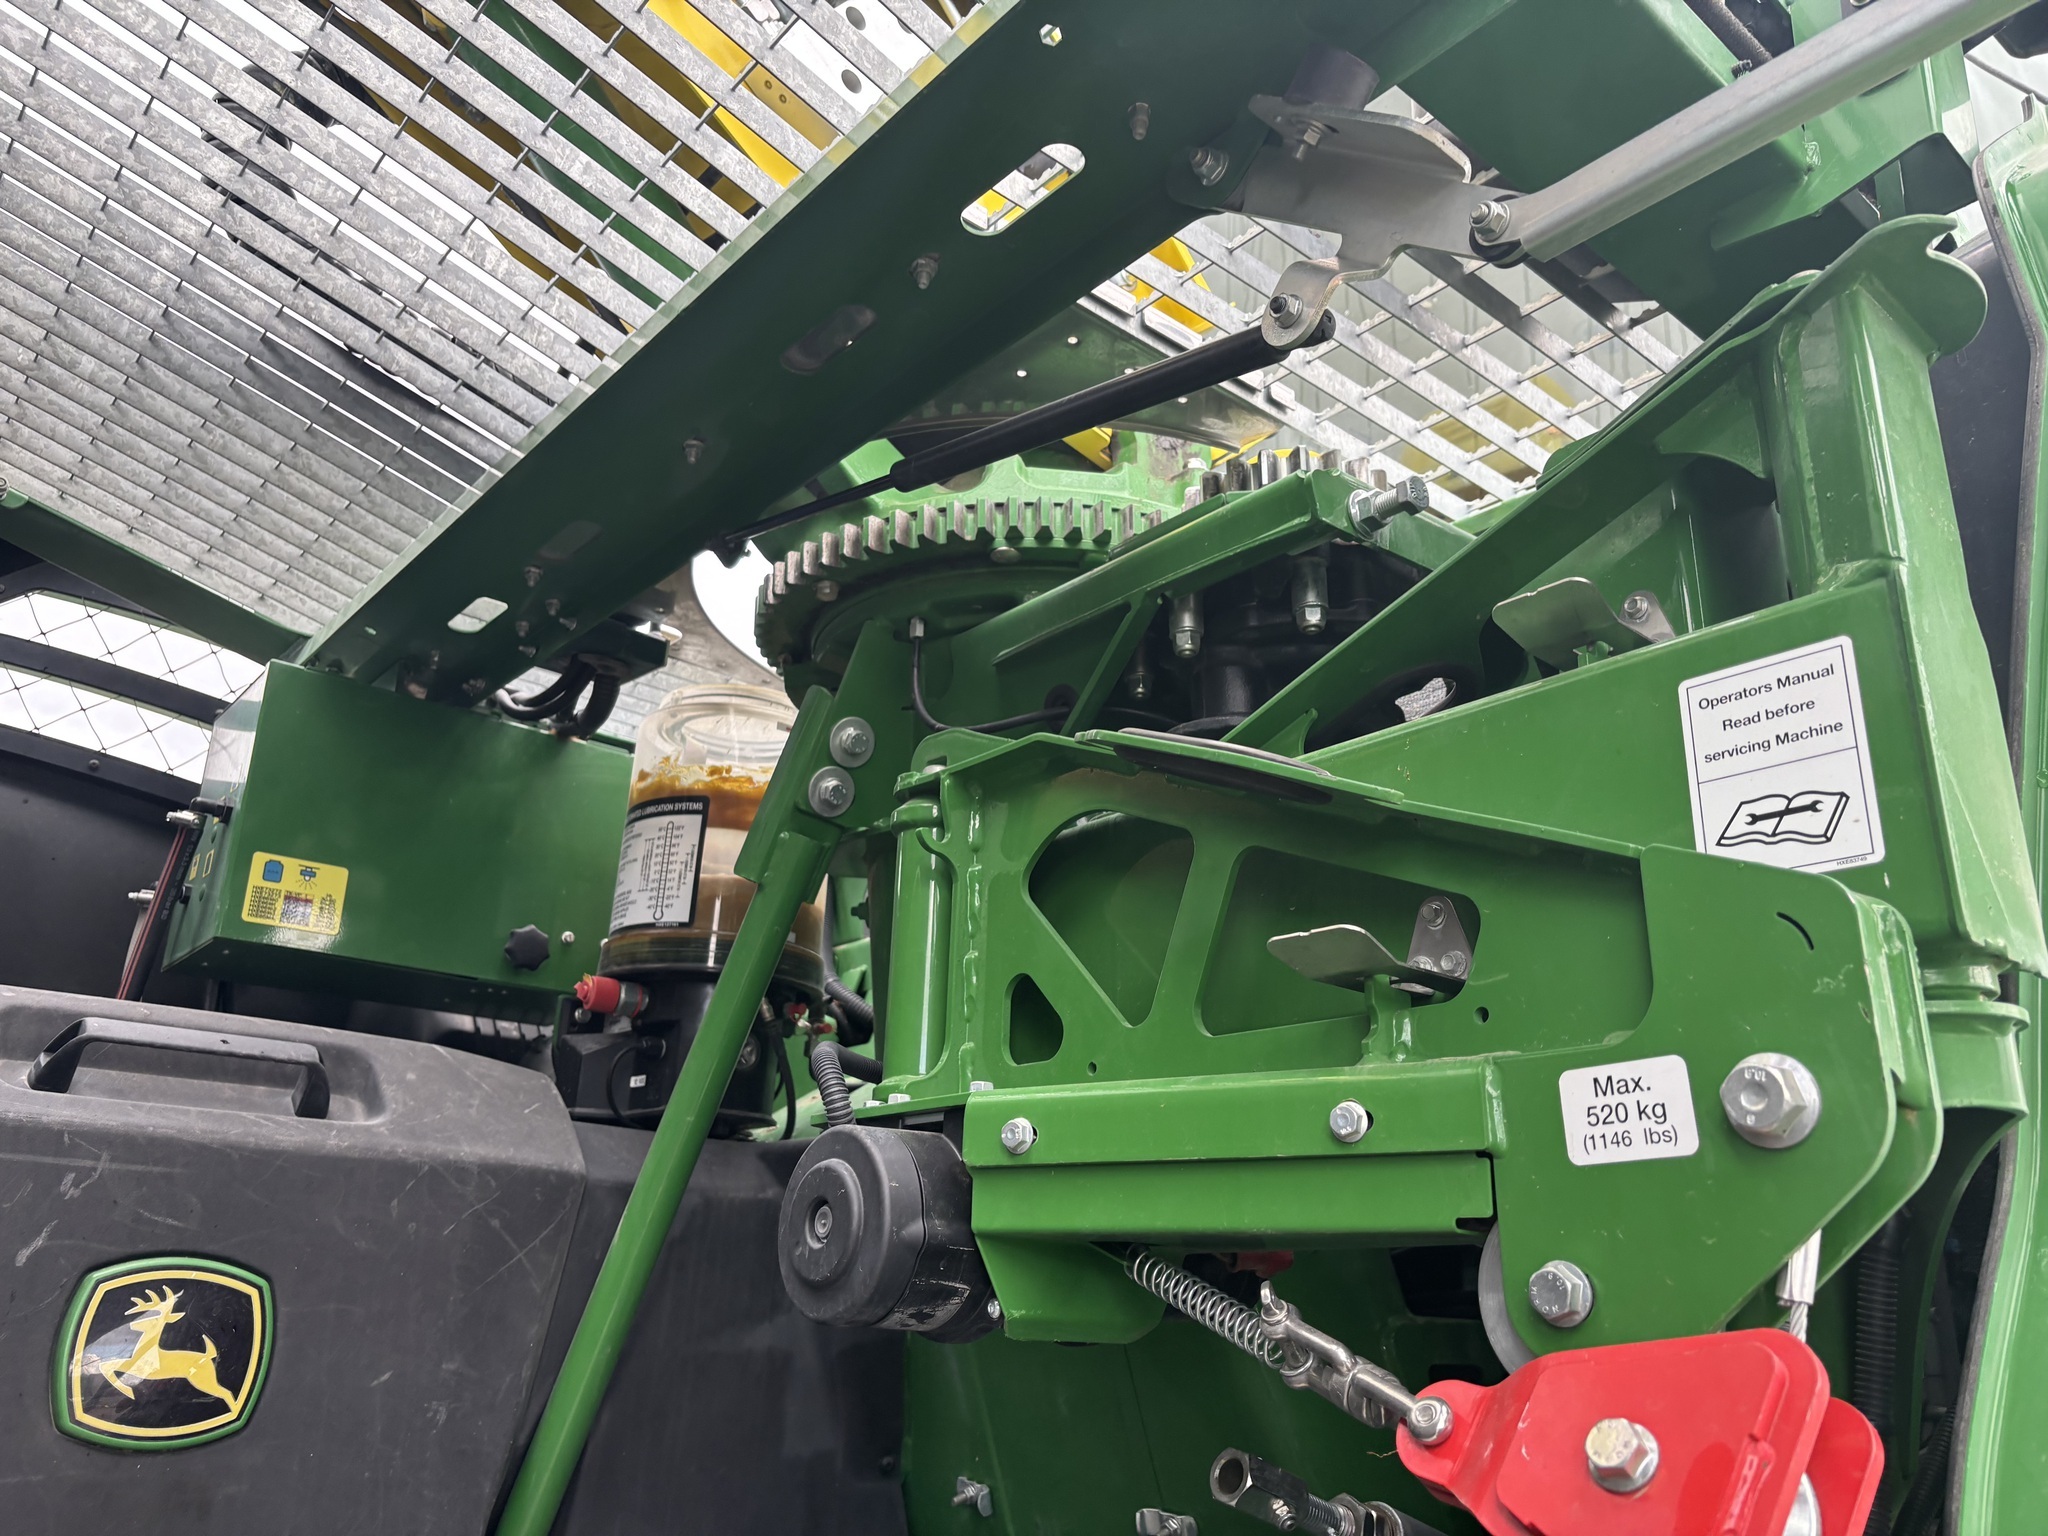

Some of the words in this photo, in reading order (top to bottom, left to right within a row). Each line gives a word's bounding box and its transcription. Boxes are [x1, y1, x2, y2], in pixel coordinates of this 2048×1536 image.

[1698, 683, 1772, 710] Operators
[1776, 663, 1835, 690] Manual
[1722, 711, 1761, 731] Read
[1765, 700, 1815, 720] before
[1704, 739, 1771, 763] servicing
[1775, 721, 1843, 746] Machine
[641, 803, 673, 816] LUBRICATION
[674, 802, 703, 811] SYSTEMS
[1592, 1075, 1651, 1098] Max.
[1587, 1102, 1628, 1127] 520
[1637, 1100, 1667, 1125] kg
[1583, 1130, 1632, 1155] (1146
[1644, 1124, 1678, 1147] lbs)
